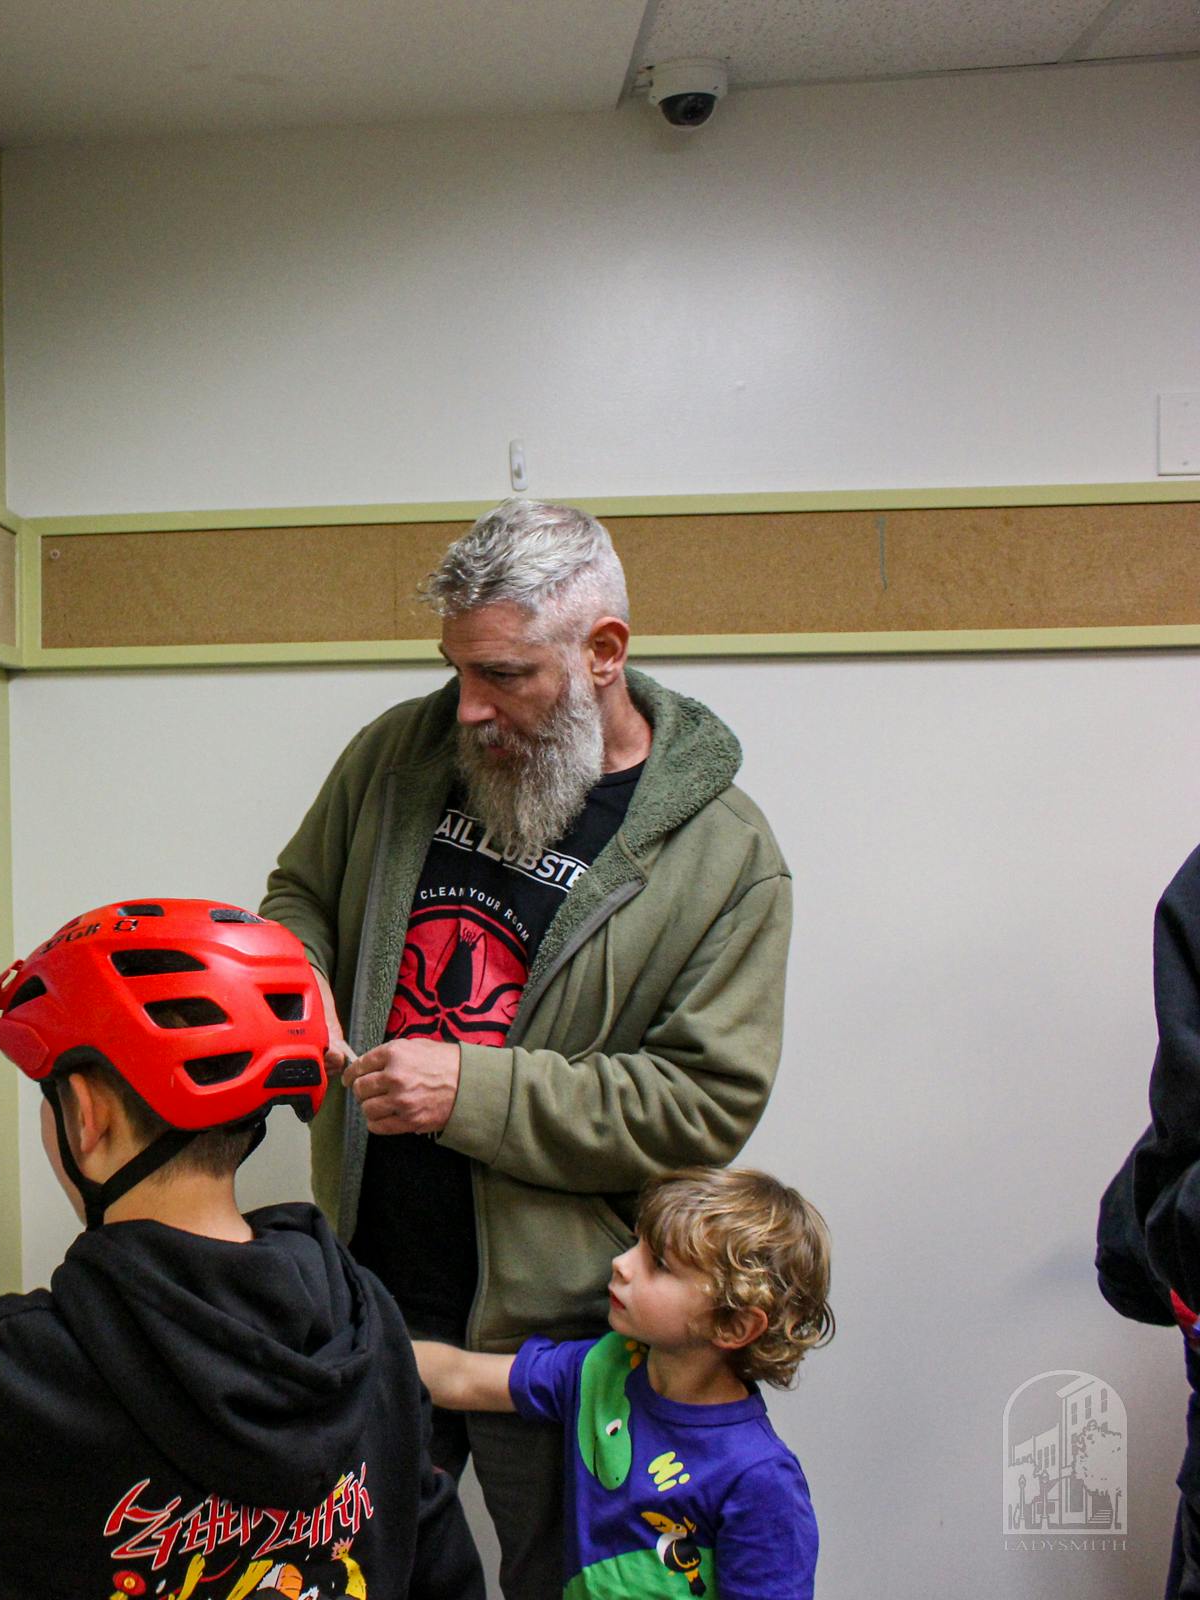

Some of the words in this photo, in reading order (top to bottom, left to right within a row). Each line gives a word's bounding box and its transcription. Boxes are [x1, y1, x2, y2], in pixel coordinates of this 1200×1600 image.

[420, 886, 465, 900] CLEAN
[468, 887, 501, 911] YOUR
[503, 908, 530, 942] ROOM
